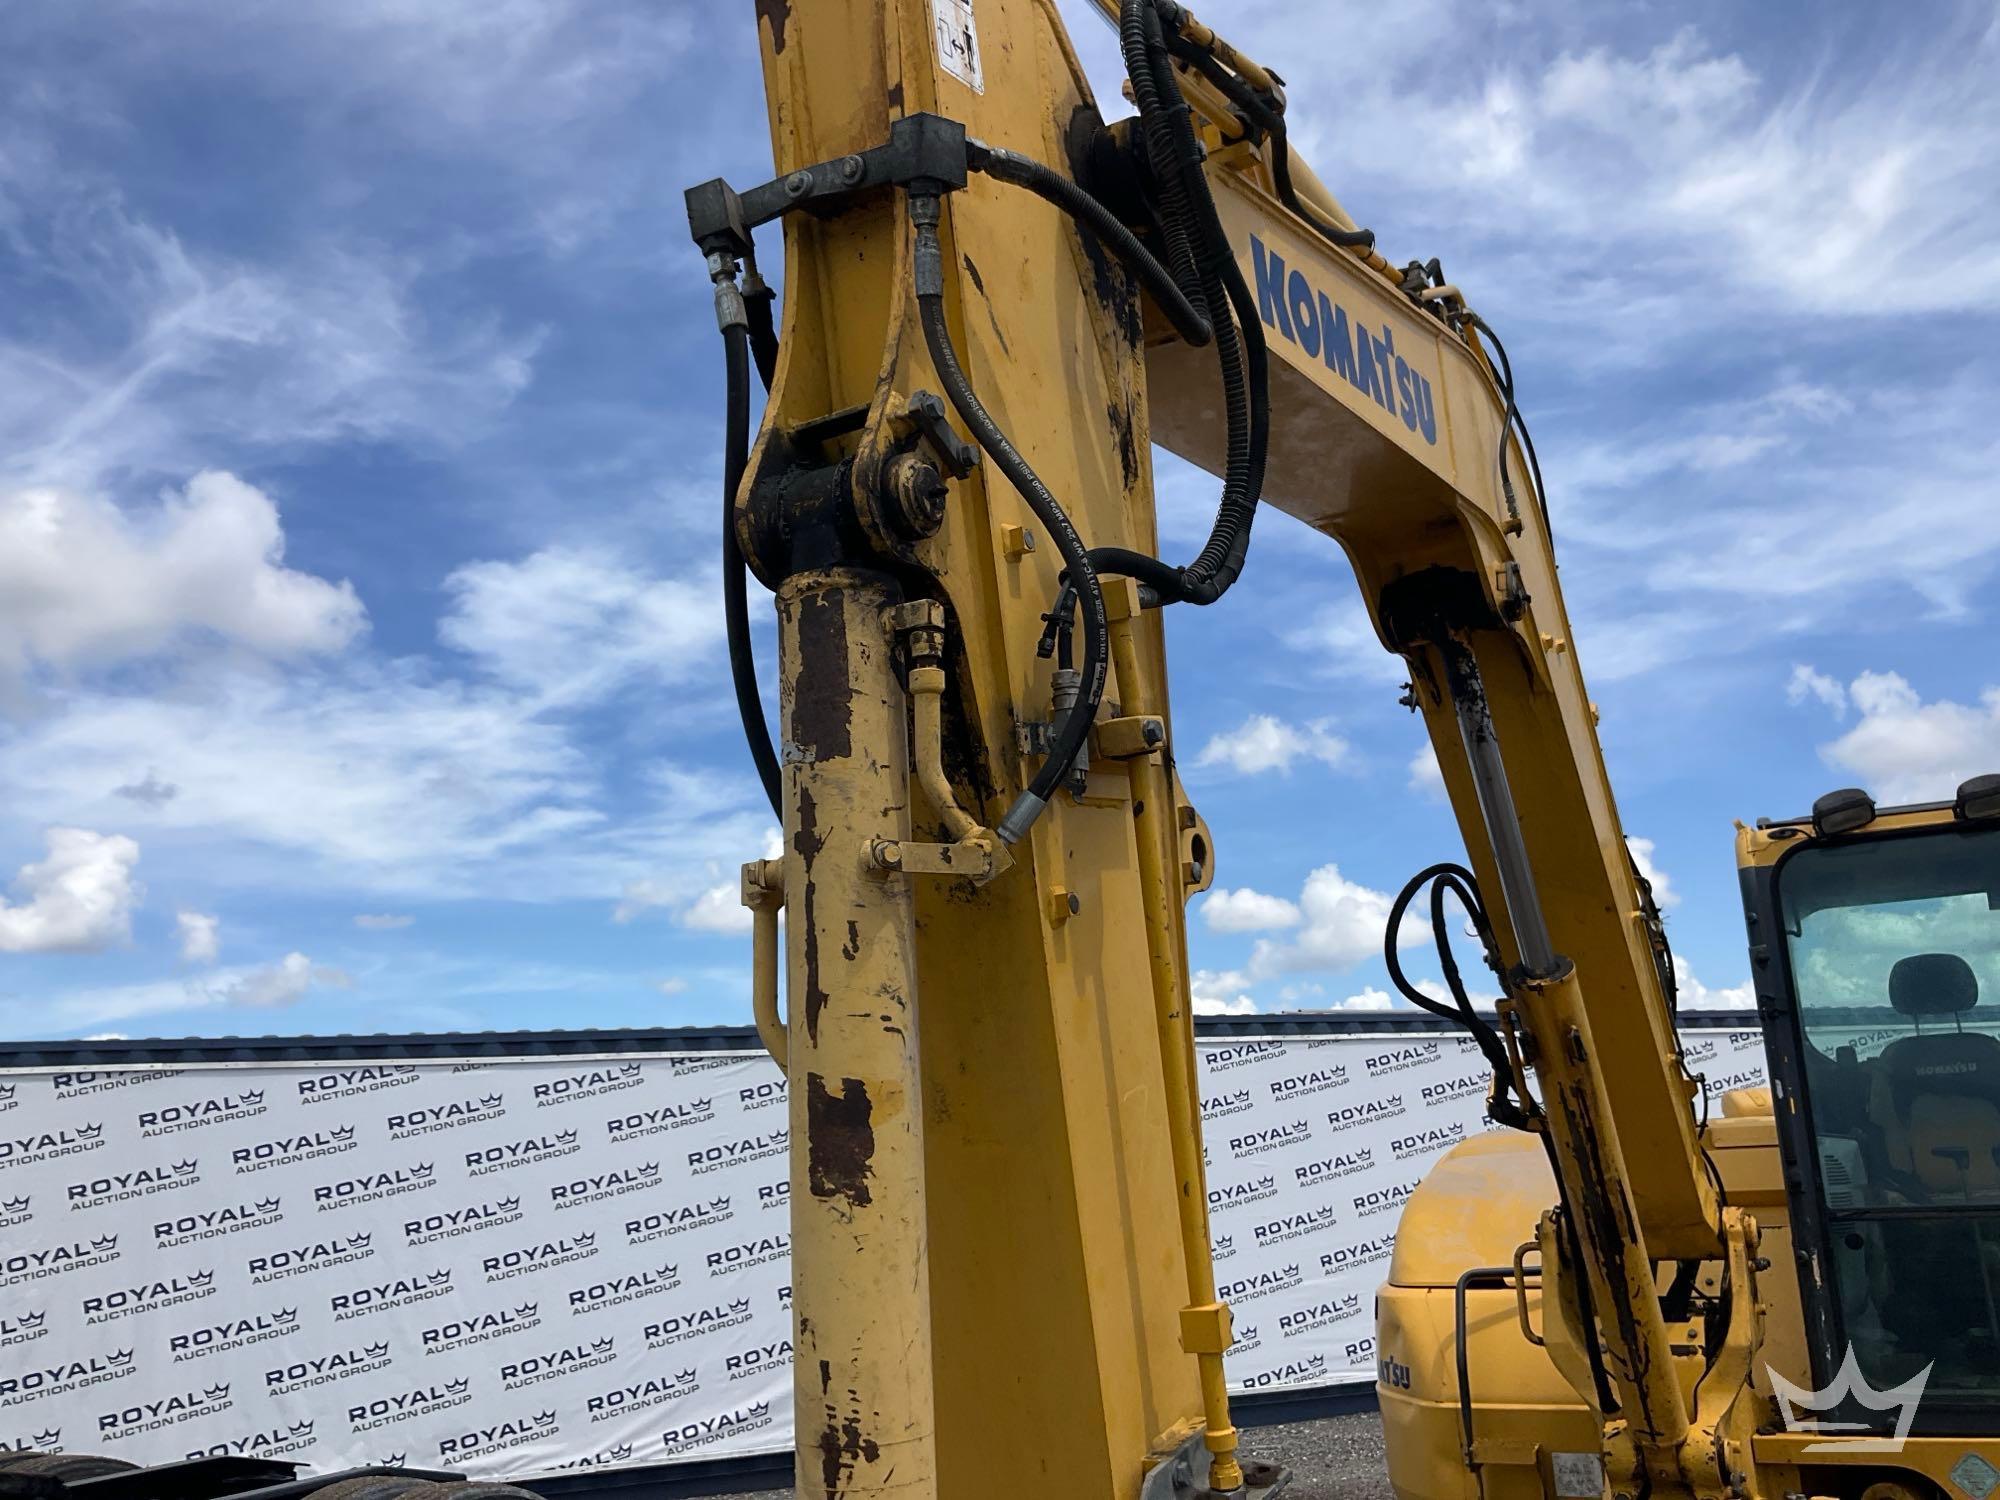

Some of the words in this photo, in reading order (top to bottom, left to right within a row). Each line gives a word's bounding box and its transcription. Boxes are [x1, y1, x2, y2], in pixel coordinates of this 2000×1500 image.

[1250, 232, 1437, 446] KOMATSU
[1000, 439, 1021, 464] MSHA
[1060, 521, 1076, 540] 29.7
[1073, 540, 1084, 557] WP
[1093, 663, 1105, 698] Parker
[1205, 1041, 1268, 1065] ROYAL
[1211, 1058, 1252, 1073] AUCTION
[1254, 1050, 1286, 1062] GROUP
[1365, 1046, 1424, 1069] ROYAL
[1370, 1063, 1409, 1077] AUCTION
[1411, 1055, 1441, 1067] GROUP
[57, 1080, 126, 1100] AUCTION
[299, 1064, 393, 1094] ROYAL
[303, 1086, 366, 1105] AUCTION
[370, 1075, 418, 1090] GROUP
[534, 1068, 620, 1098] ROYAL
[538, 1089, 595, 1107] AUCTION
[599, 1079, 643, 1094] GROUP
[1270, 1069, 1331, 1094] ROYAL
[1275, 1087, 1316, 1102] AUCTION
[1318, 1078, 1349, 1090] GROUP
[1421, 1074, 1479, 1098] ROYAL
[139, 1095, 240, 1127] ROYAL
[388, 1099, 480, 1130] ROYAL
[1328, 1099, 1388, 1124] ROYAL
[1426, 1092, 1464, 1106] AUCTION
[143, 1118, 210, 1138] AUCTION
[214, 1106, 266, 1123] GROUP
[392, 1121, 453, 1140] AUCTION
[457, 1110, 504, 1126] GROUP
[608, 1103, 691, 1133] ROYAL
[612, 1124, 668, 1143] AUCTION
[671, 1114, 714, 1129] GROUP
[1333, 1117, 1373, 1132] AUCTION
[1374, 1108, 1406, 1120] GROUP
[233, 1130, 330, 1163] ROYAL
[466, 1135, 555, 1166] ROYAL
[688, 1135, 769, 1165] ROYAL
[1230, 1124, 1292, 1150] ROYAL
[1235, 1143, 1276, 1158] AUCTION
[1278, 1134, 1311, 1147] GROUP
[1390, 1127, 1450, 1152] ROYAL
[1396, 1145, 1435, 1160] AUCTION
[1436, 1136, 1467, 1148] GROUP
[237, 1154, 302, 1174] AUCTION
[306, 1142, 357, 1158] GROUP
[470, 1157, 530, 1176] AUCTION
[534, 1146, 580, 1162] GROUP
[692, 1156, 747, 1175] AUCTION
[750, 1145, 792, 1161] GROUP
[1295, 1153, 1356, 1179] ROYAL
[68, 1165, 172, 1200] ROYAL
[315, 1168, 410, 1201] ROYAL
[551, 1168, 638, 1200] ROYAL
[1300, 1171, 1341, 1187] AUCTION
[1343, 1162, 1375, 1175] GROUP
[72, 1189, 142, 1211] AUCTION
[146, 1177, 200, 1194] GROUP
[319, 1192, 382, 1212] AUCTION
[387, 1179, 436, 1196] GROUP
[555, 1190, 613, 1210] AUCTION
[617, 1178, 661, 1194] GROUP
[1353, 1182, 1414, 1209] ROYAL
[1358, 1201, 1398, 1217] AUCTION
[154, 1203, 256, 1238] ROYAL
[158, 1227, 226, 1249] AUCTION
[230, 1214, 282, 1232] GROUP
[405, 1202, 497, 1236] ROYAL
[409, 1226, 471, 1246] AUCTION
[475, 1213, 522, 1230] GROUP
[625, 1202, 710, 1234] ROYAL
[629, 1224, 686, 1244] AUCTION
[689, 1212, 733, 1229] GROUP
[1254, 1211, 1317, 1238] ROYAL
[1260, 1230, 1301, 1246] AUCTION
[1303, 1220, 1336, 1234] GROUP
[64, 1252, 120, 1271] GROUP
[249, 1238, 347, 1274] ROYAL
[484, 1238, 573, 1272] ROYAL
[488, 1261, 548, 1282] AUCTION
[551, 1249, 598, 1266] GROUP
[707, 1234, 788, 1266] ROYAL
[711, 1256, 766, 1276] AUCTION
[1320, 1239, 1382, 1266] ROYAL
[253, 1262, 319, 1284] AUCTION
[323, 1249, 374, 1267] GROUP
[1325, 1258, 1366, 1275] AUCTION
[83, 1276, 188, 1314] ROYAL
[332, 1275, 427, 1311] ROYAL
[569, 1270, 656, 1304] ROYAL
[573, 1294, 632, 1315] AUCTION
[635, 1281, 680, 1298] GROUP
[1219, 1269, 1283, 1298] ROYAL
[1269, 1278, 1302, 1293] GROUP
[87, 1302, 157, 1325] AUCTION
[162, 1287, 216, 1306] GROUP
[336, 1299, 400, 1321] AUCTION
[404, 1286, 453, 1304] GROUP
[1279, 1299, 1343, 1328] ROYAL
[170, 1313, 272, 1351] ROYAL
[423, 1308, 515, 1345] ROYAL
[426, 1333, 488, 1355] AUCTION
[492, 1319, 540, 1337] GROUP
[644, 1304, 729, 1339] ROYAL
[648, 1328, 705, 1349] AUCTION
[708, 1314, 752, 1332] GROUP
[1285, 1319, 1326, 1337] AUCTION
[1328, 1308, 1361, 1323] GROUP
[174, 1339, 242, 1362] AUCTION
[247, 1324, 299, 1344] GROUP
[0, 1356, 107, 1396] ROYAL
[266, 1348, 364, 1386] ROYAL
[270, 1373, 336, 1397] AUCTION
[340, 1358, 391, 1378] GROUP
[501, 1344, 591, 1380] ROYAL
[505, 1368, 566, 1390] AUCTION
[569, 1354, 616, 1372] GROUP
[730, 1359, 785, 1380] AUCTION
[2, 1382, 75, 1407] AUCTION
[80, 1367, 136, 1387] GROUP
[349, 1384, 445, 1422] ROYAL
[588, 1375, 675, 1412] ROYAL
[99, 1390, 204, 1430] ROYAL
[353, 1409, 417, 1433] AUCTION
[422, 1394, 471, 1414] GROUP
[592, 1399, 650, 1422] AUCTION
[654, 1385, 699, 1404] GROUP
[102, 1417, 173, 1442] AUCTION
[178, 1401, 232, 1421] GROUP
[440, 1416, 533, 1455] ROYAL
[663, 1408, 748, 1445] ROYAL
[667, 1432, 724, 1455] AUCTION
[728, 1418, 772, 1437] GROUP
[263, 1437, 316, 1458] GROUP
[444, 1442, 507, 1466] AUCTION
[510, 1427, 558, 1446] GROUP
